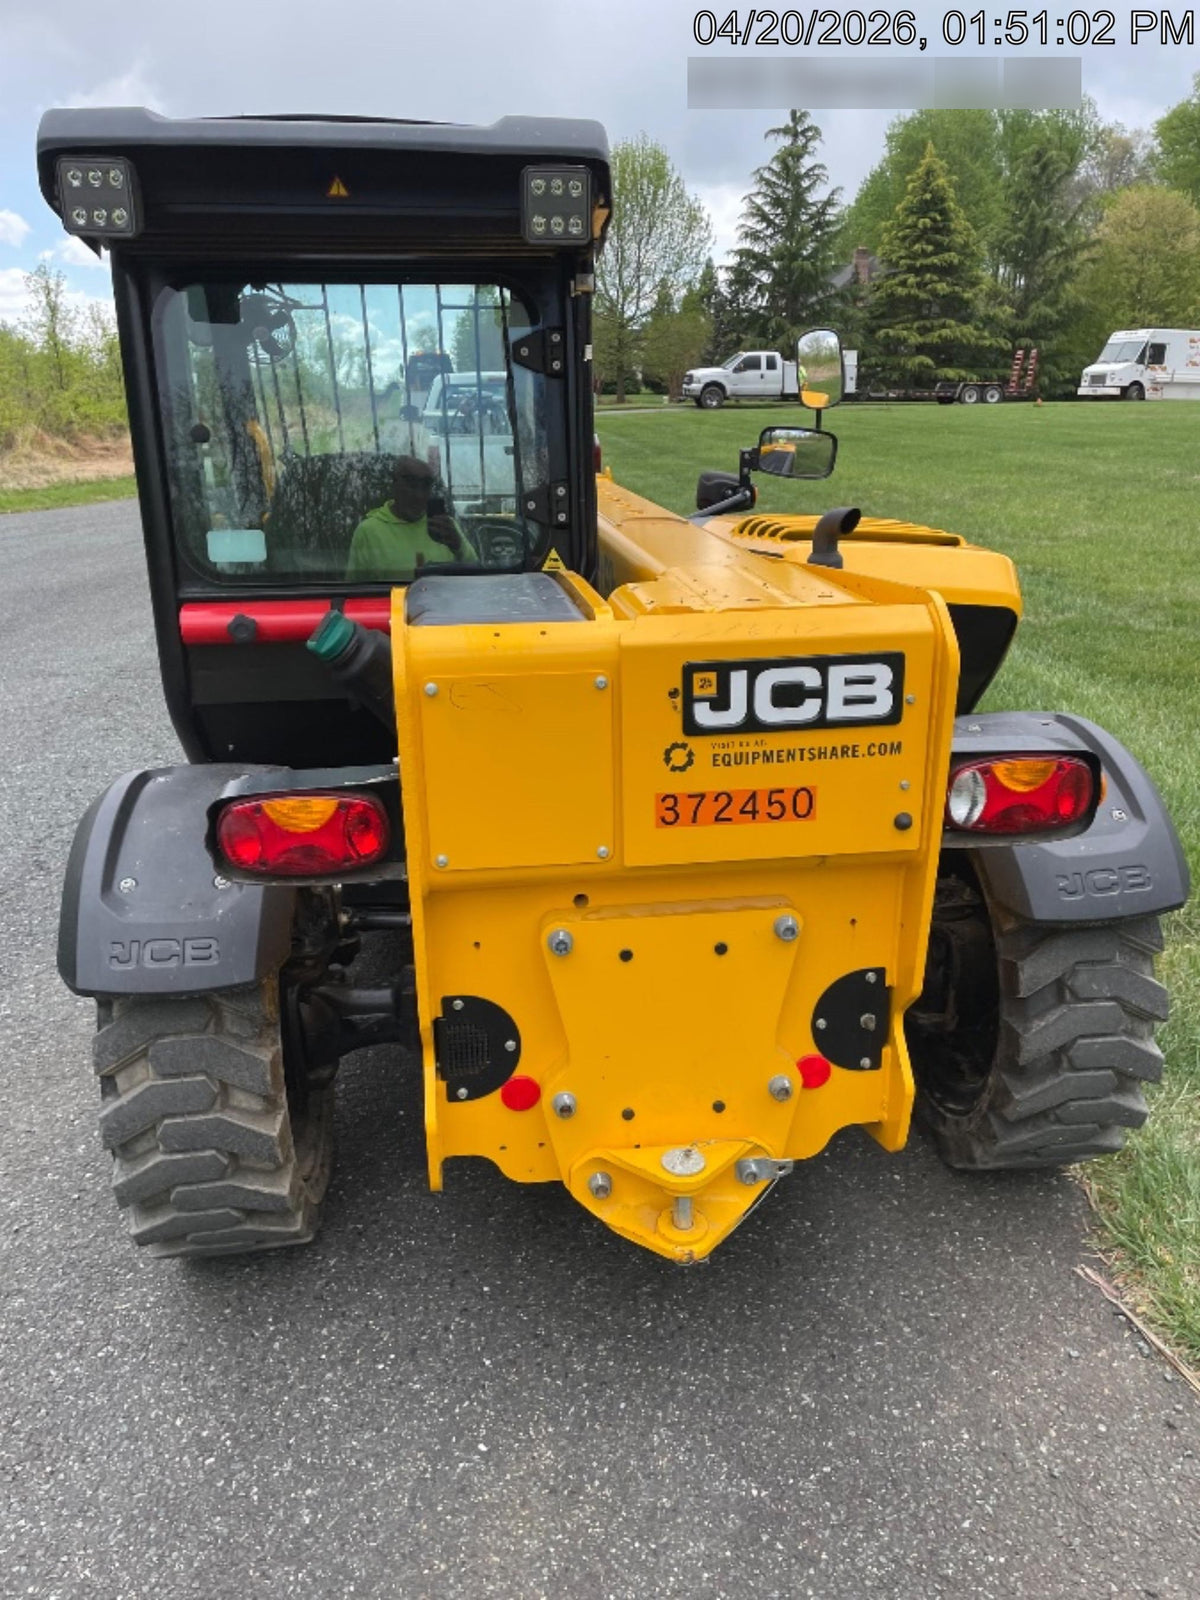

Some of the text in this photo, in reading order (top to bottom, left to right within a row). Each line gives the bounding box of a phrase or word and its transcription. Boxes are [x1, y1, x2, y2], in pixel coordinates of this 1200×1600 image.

[693, 663, 894, 729] JCB
[712, 741, 902, 767] EQUIPMENTSHARE.COM
[660, 787, 814, 826] 372450
[1055, 865, 1153, 900] JCB
[109, 936, 220, 970] JCB
